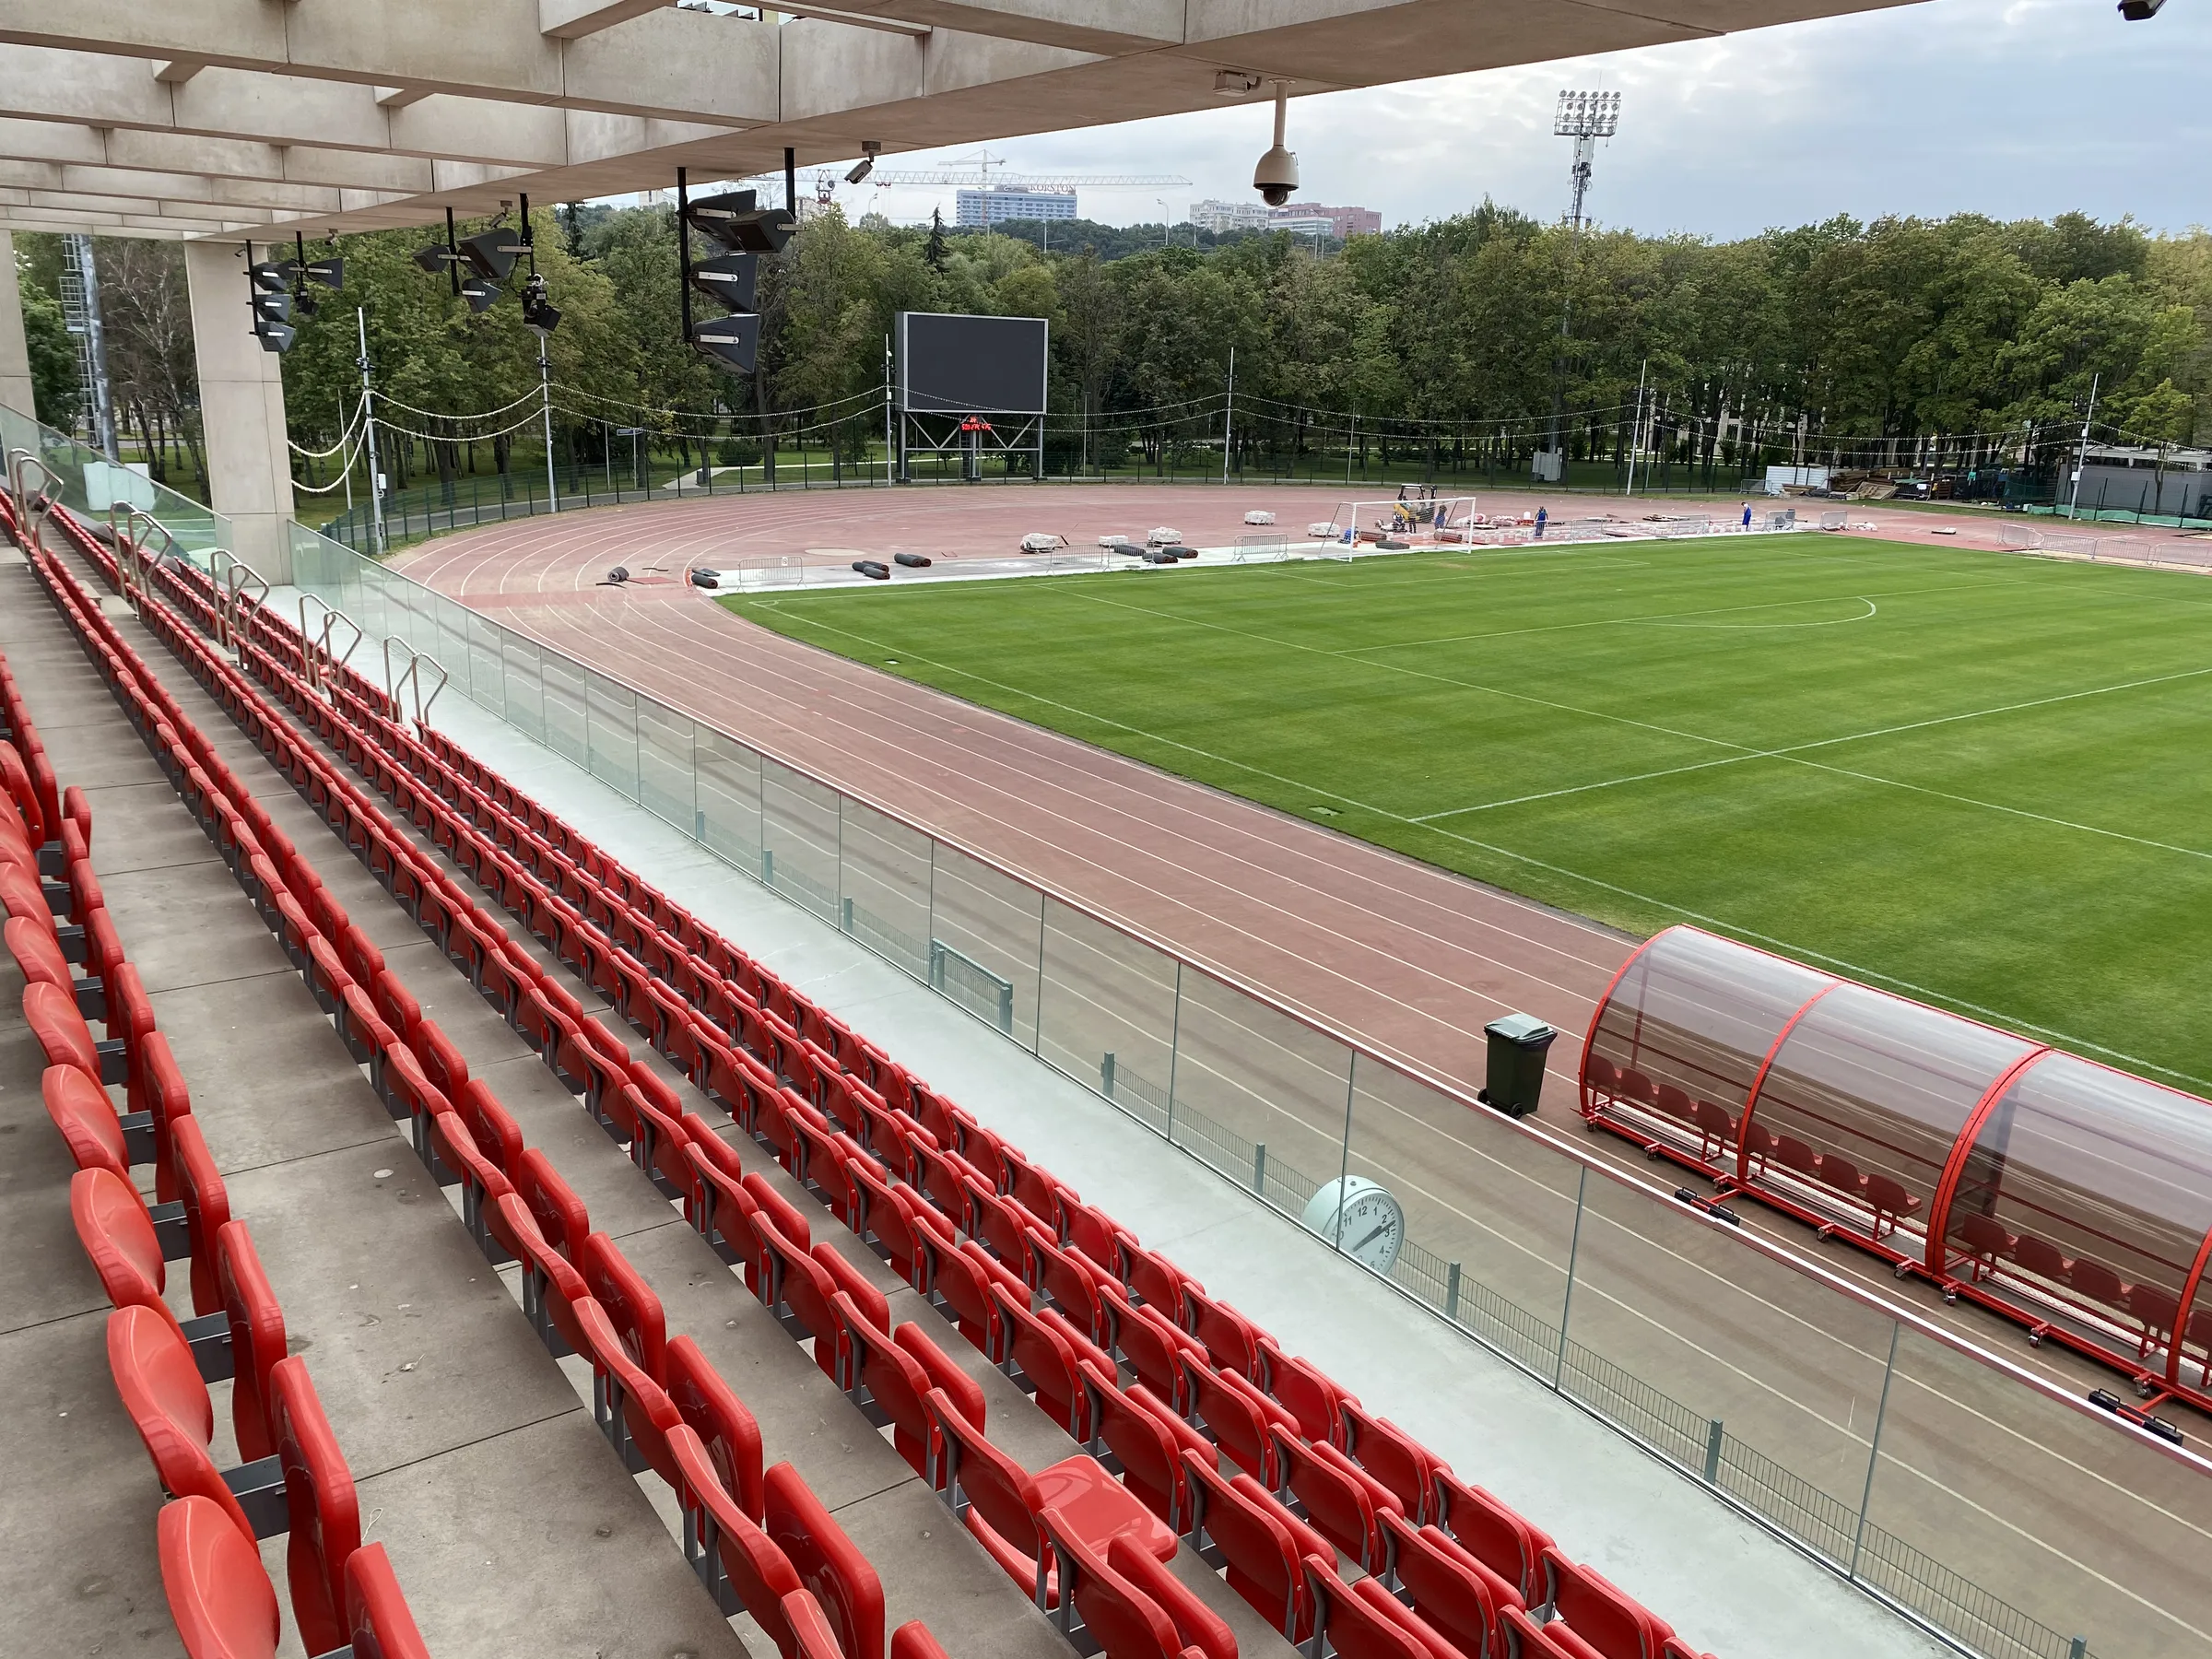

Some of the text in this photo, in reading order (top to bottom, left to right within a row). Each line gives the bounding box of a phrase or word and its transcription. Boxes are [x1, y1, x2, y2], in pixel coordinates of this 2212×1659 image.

[1358, 1206, 1367, 1217] 12
[1373, 1206, 1378, 1216] 1
[1344, 1216, 1352, 1227] 11
[1382, 1214, 1387, 1224] 2
[1384, 1228, 1390, 1238] 3
[1379, 1245, 1384, 1254] 4
